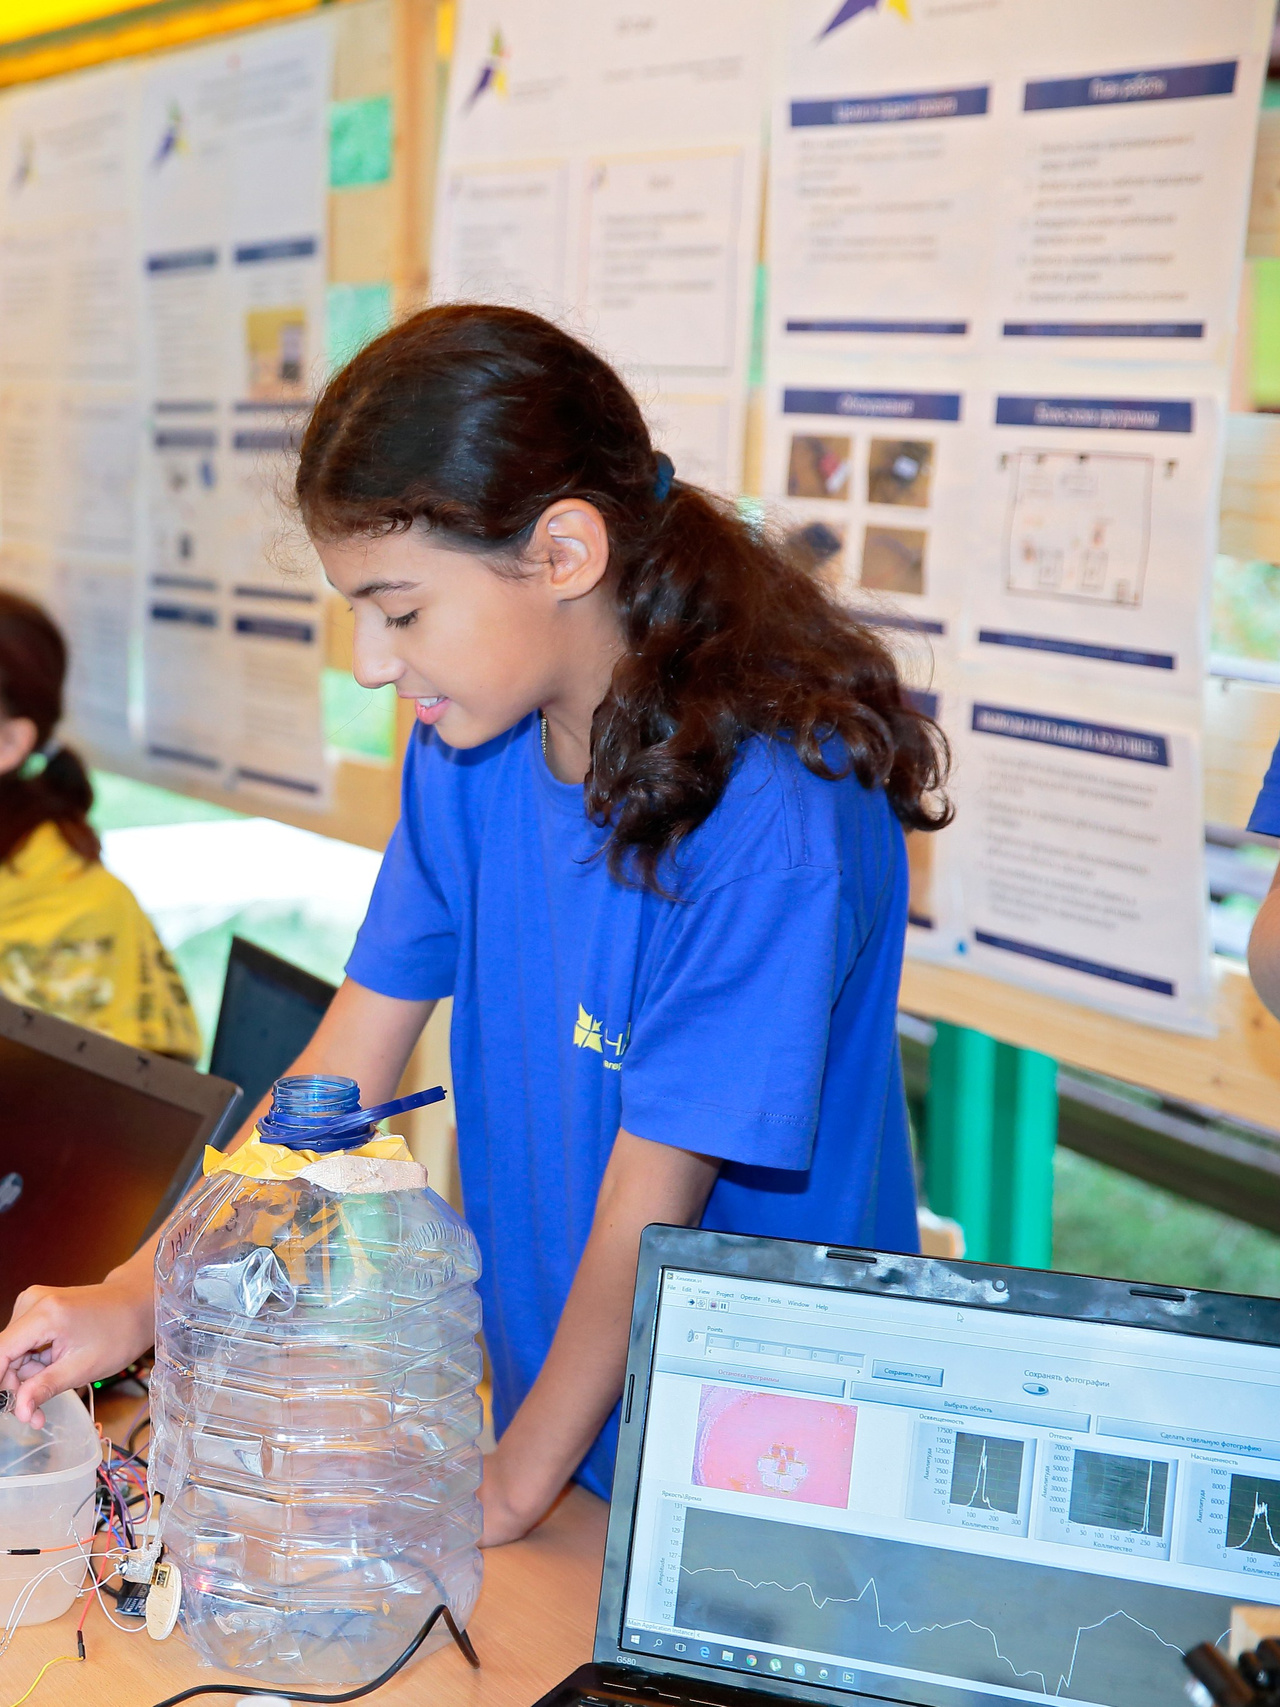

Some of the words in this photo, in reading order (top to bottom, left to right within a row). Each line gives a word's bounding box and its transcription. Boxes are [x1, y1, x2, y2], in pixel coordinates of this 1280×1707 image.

[716, 1290, 734, 1299] Project
[740, 1294, 762, 1302] Operate
[787, 1300, 810, 1308] Window
[816, 1304, 829, 1312] Help
[718, 1369, 746, 1378] Остановка
[747, 1374, 780, 1382] программы
[884, 1367, 914, 1378] Сохранить
[1024, 1370, 1062, 1381] Сохранять
[1064, 1376, 1110, 1388] фотографии
[944, 1401, 968, 1410] Выбрать
[970, 1404, 993, 1413] область
[1048, 1432, 1073, 1441] Оттенок
[1160, 1432, 1185, 1442] Сделать
[1186, 1436, 1220, 1446] отдельную
[1220, 1441, 1262, 1452] фотографию
[924, 1448, 932, 1480] Амплитуда
[1190, 1453, 1238, 1465] Насыщенность
[1042, 1466, 1050, 1498] Амплитуда
[1196, 1489, 1205, 1523] Амплитуда
[628, 1619, 642, 1628] Main
[642, 1622, 671, 1632] Application
[672, 1627, 694, 1636] Instance
[616, 1656, 637, 1666] G580
